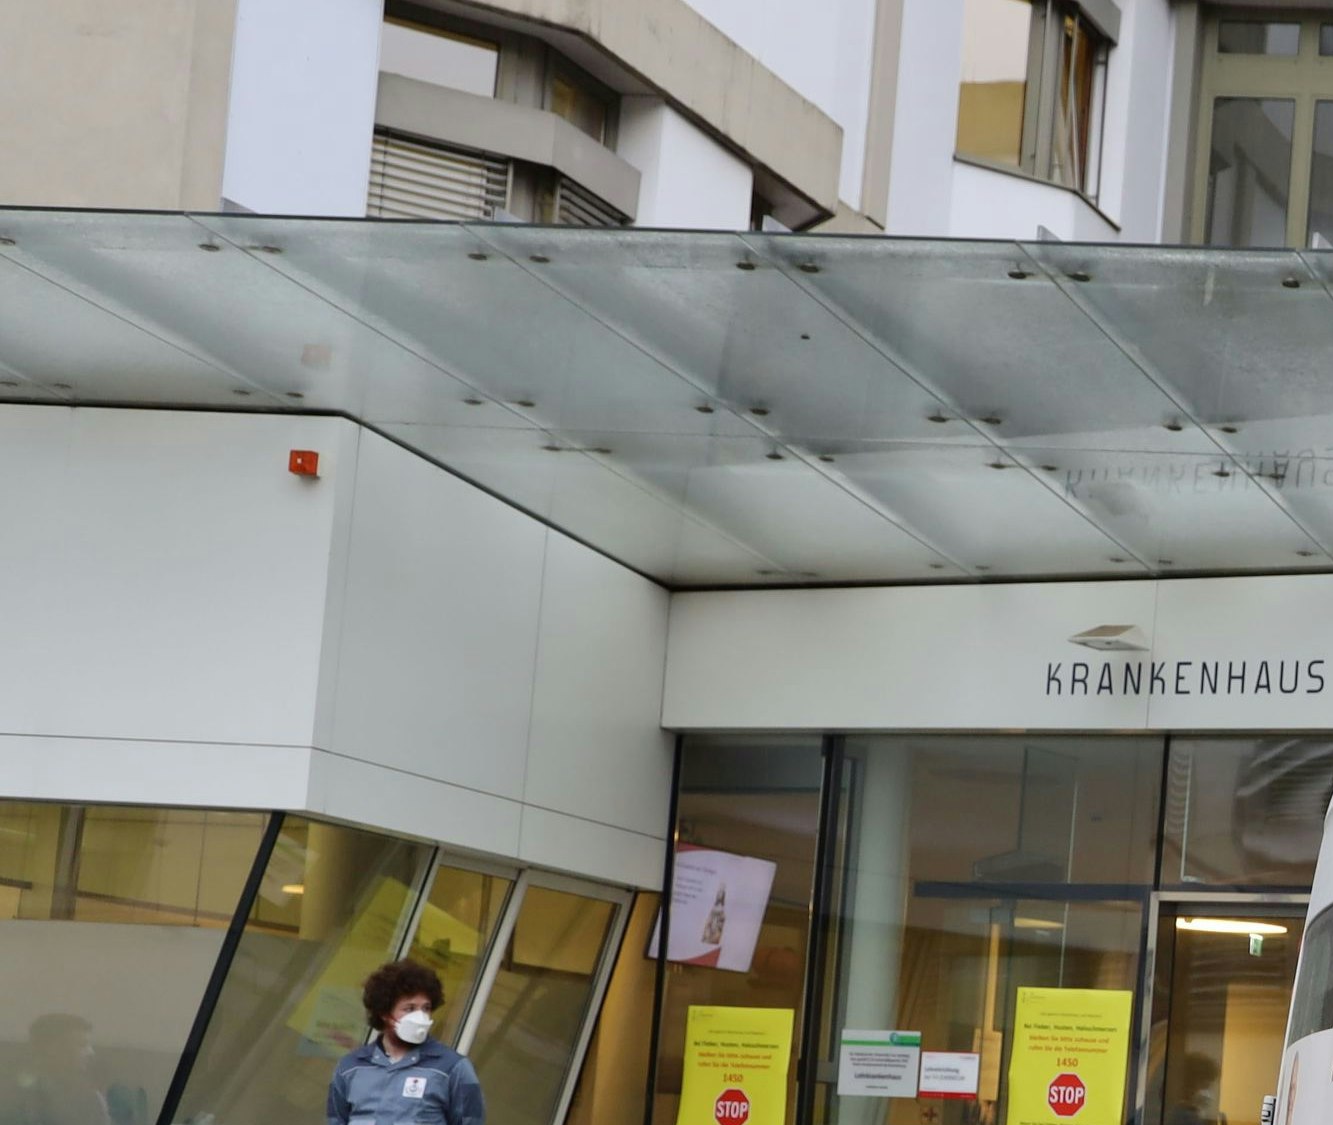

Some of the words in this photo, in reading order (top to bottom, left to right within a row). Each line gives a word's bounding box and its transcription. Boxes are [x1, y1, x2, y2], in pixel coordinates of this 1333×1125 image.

[1046, 660, 1325, 695] KRANKENHAUS
[1056, 1057, 1078, 1067] 1450
[723, 1073, 744, 1083] 1450
[1049, 1085, 1084, 1105] STOP
[716, 1100, 749, 1119] STOP
